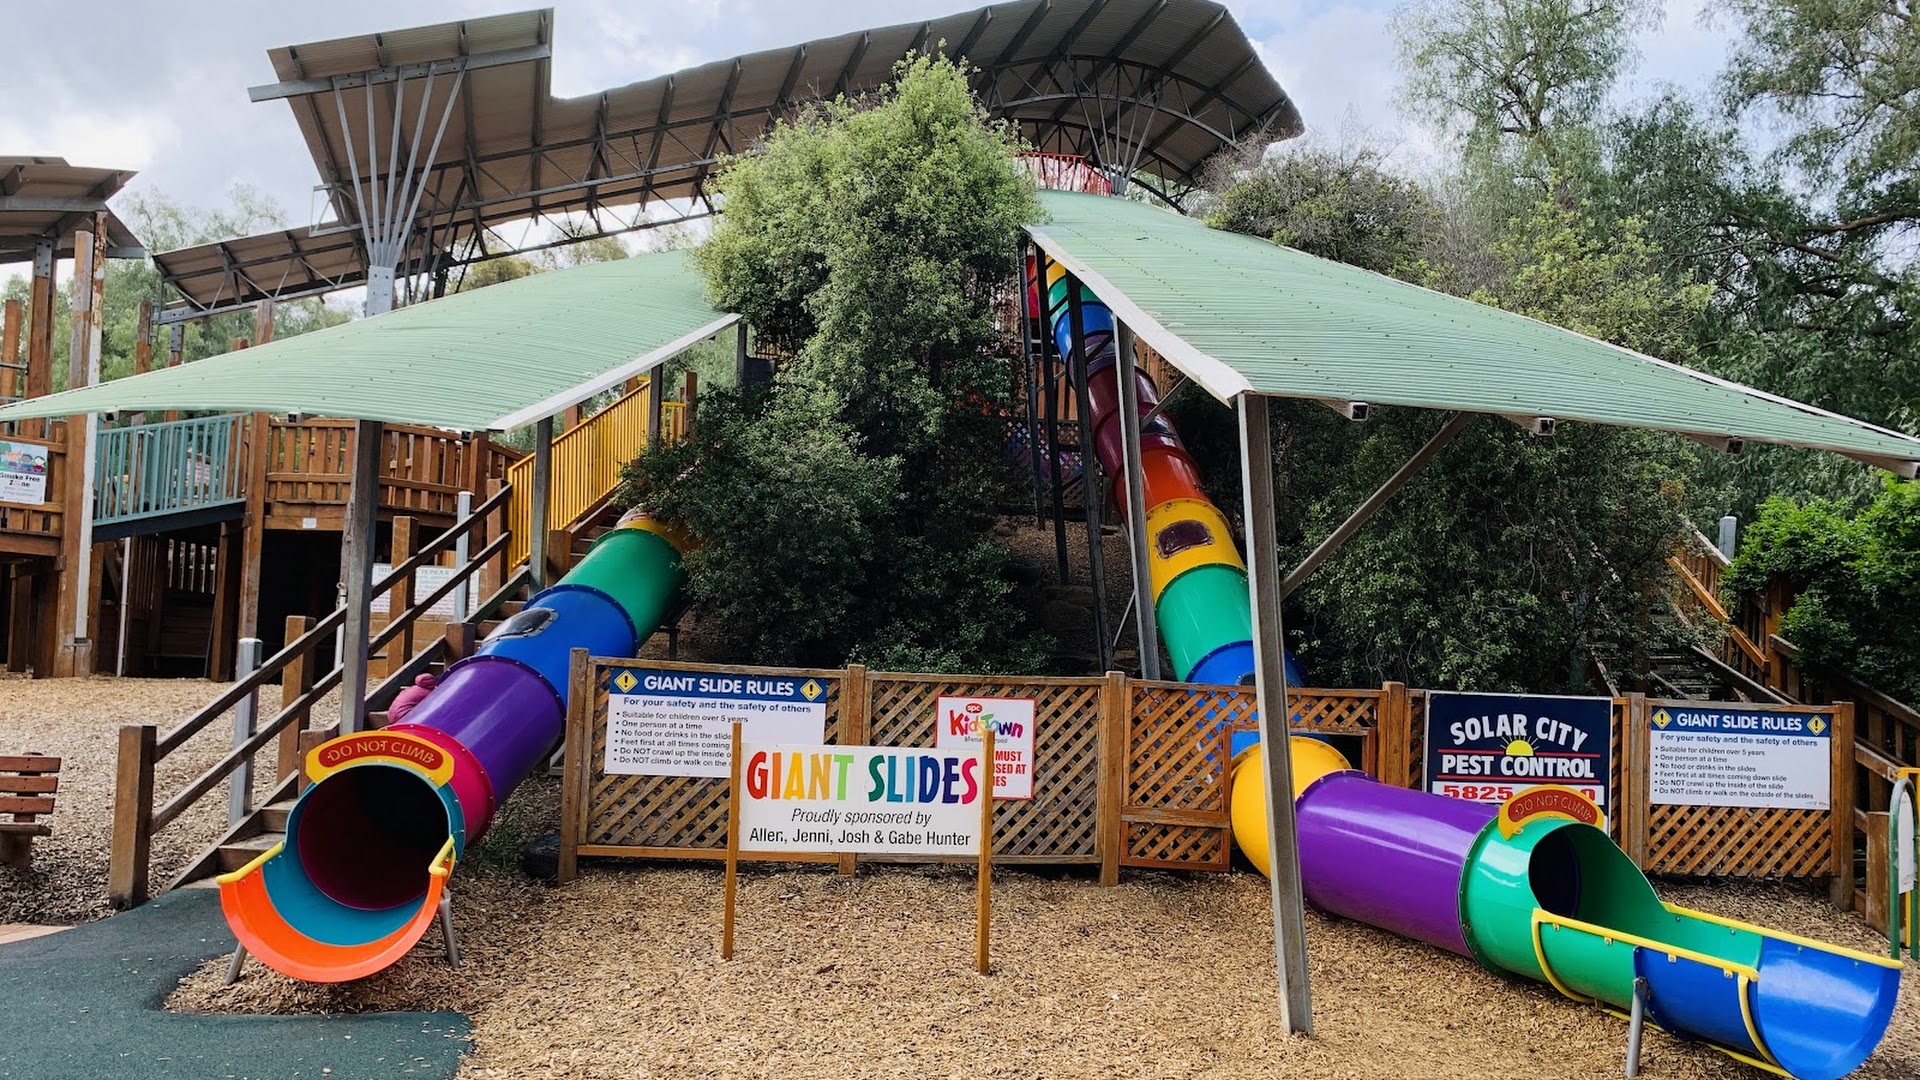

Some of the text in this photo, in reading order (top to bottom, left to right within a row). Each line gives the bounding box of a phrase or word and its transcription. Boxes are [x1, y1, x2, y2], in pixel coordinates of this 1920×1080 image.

[9, 480, 30, 488] Zne
[644, 675, 794, 696] GIANT SLIDE RULES
[623, 697, 812, 714] For your safety and the safety of others
[966, 704, 980, 712] spc
[622, 710, 654, 718] Suitable
[656, 712, 666, 720] for
[668, 712, 700, 720] children
[640, 722, 667, 730] person
[686, 722, 702, 730] time
[949, 710, 1024, 738] KidsTown
[1676, 713, 1802, 731] GIANT SLIDE RULES
[664, 730, 688, 738] drinks
[714, 732, 732, 740] slide
[1450, 714, 1588, 752] SOLAR CITY
[1660, 732, 1674, 740] For
[1696, 736, 1722, 744] safety
[1740, 736, 1754, 744] the
[1756, 737, 1780, 746] safety
[1792, 738, 1818, 746] others
[640, 738, 655, 746] first
[678, 740, 700, 748] times
[702, 742, 730, 750] coming
[329, 740, 434, 763] DO NOT CLIMB
[652, 748, 674, 756] crawl
[675, 750, 686, 758] up
[702, 750, 728, 758] inside
[996, 750, 1022, 762] MUST
[632, 756, 648, 764] NOT
[684, 758, 700, 766] walk
[1442, 754, 1595, 778] PEST CONTROL
[1015, 764, 1026, 774] AT
[1724, 764, 1736, 772] the
[746, 751, 978, 804] GIANT SLIDES
[1443, 784, 1514, 800] 5825
[1686, 788, 1704, 796] climb
[1756, 782, 1767, 790] the
[1515, 794, 1592, 820] DO NOT CLIMB
[791, 808, 932, 828] Proudly sponsored by
[792, 828, 834, 846] Jenni,
[838, 829, 870, 844] Josh
[874, 832, 884, 845] &
[888, 830, 922, 846] Gabe
[926, 831, 971, 847] Hunter
